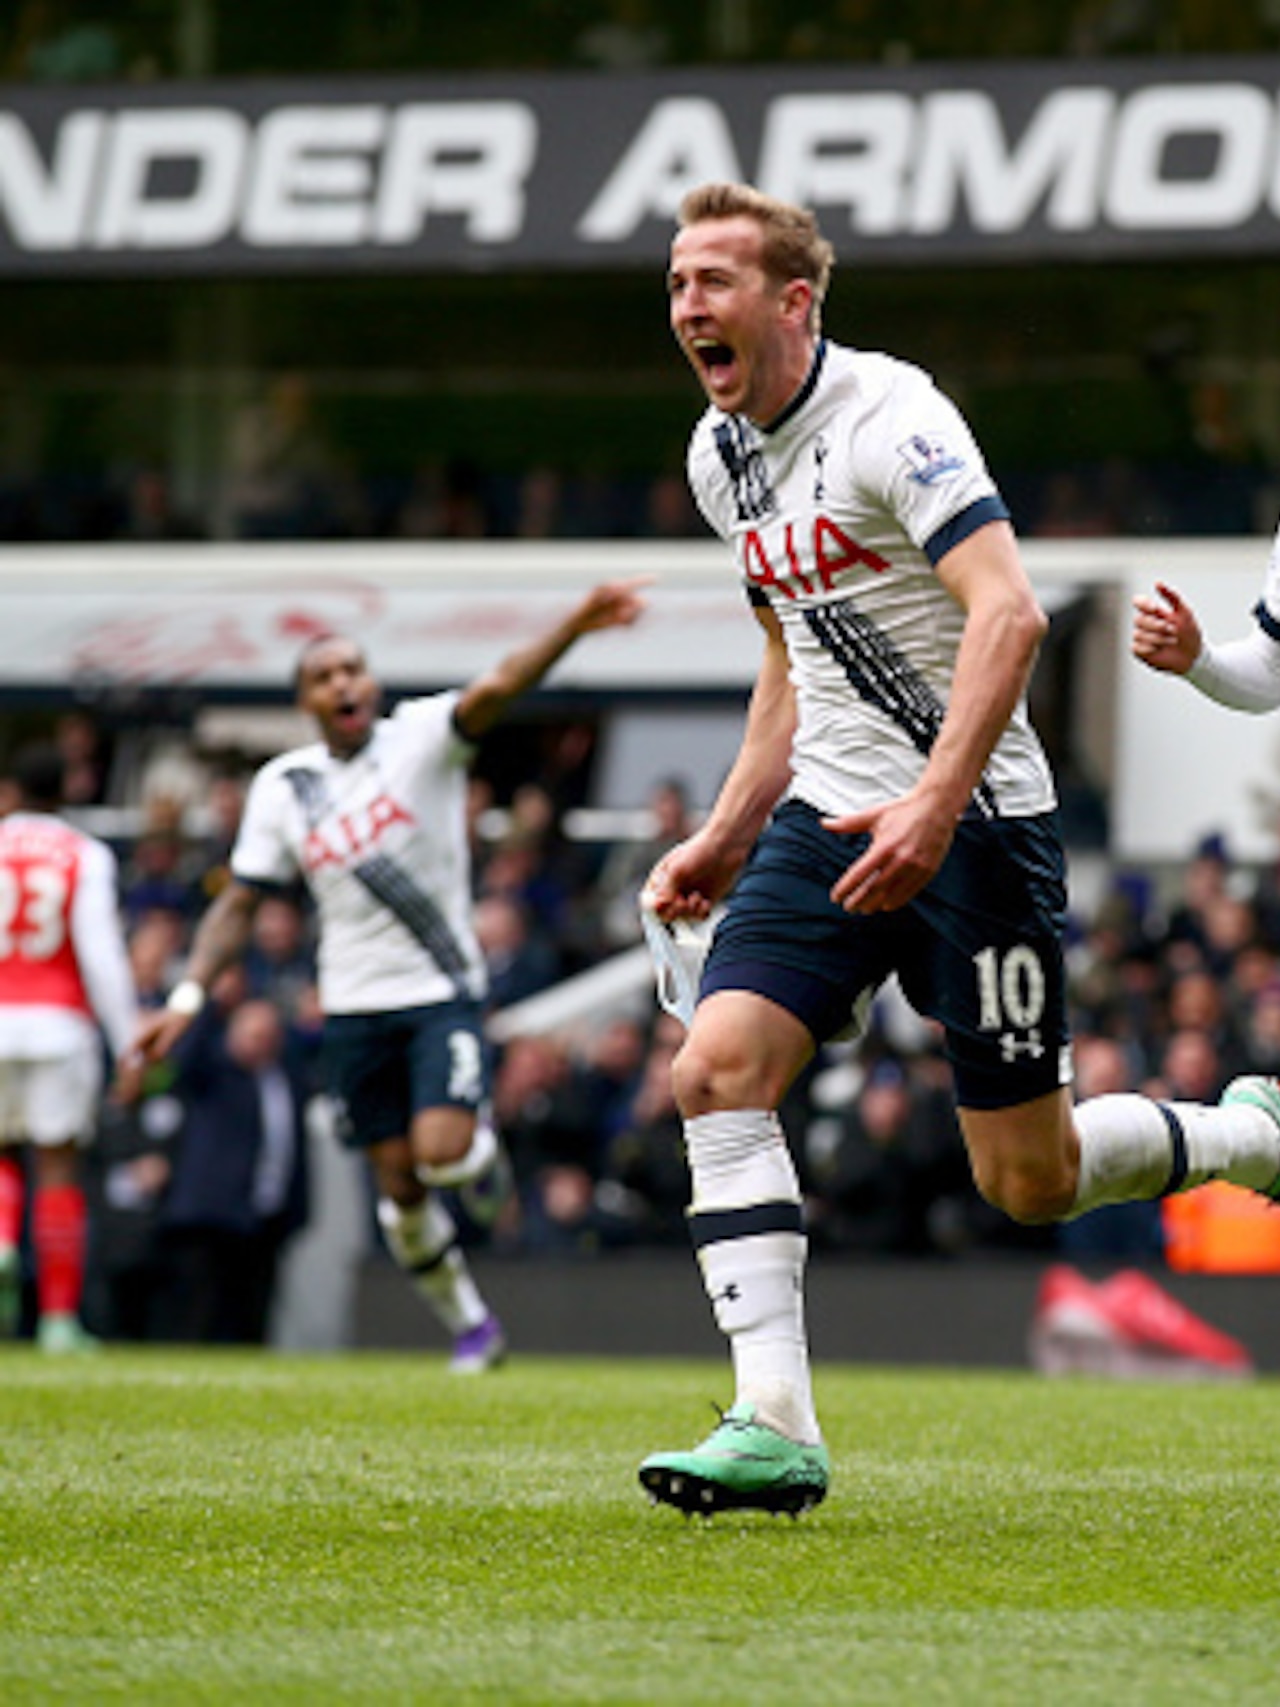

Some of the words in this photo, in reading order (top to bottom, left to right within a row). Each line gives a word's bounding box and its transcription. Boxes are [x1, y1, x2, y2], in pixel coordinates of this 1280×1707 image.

[744, 515, 891, 600] AIA
[304, 793, 417, 871] AIA
[972, 944, 1045, 1031] 10
